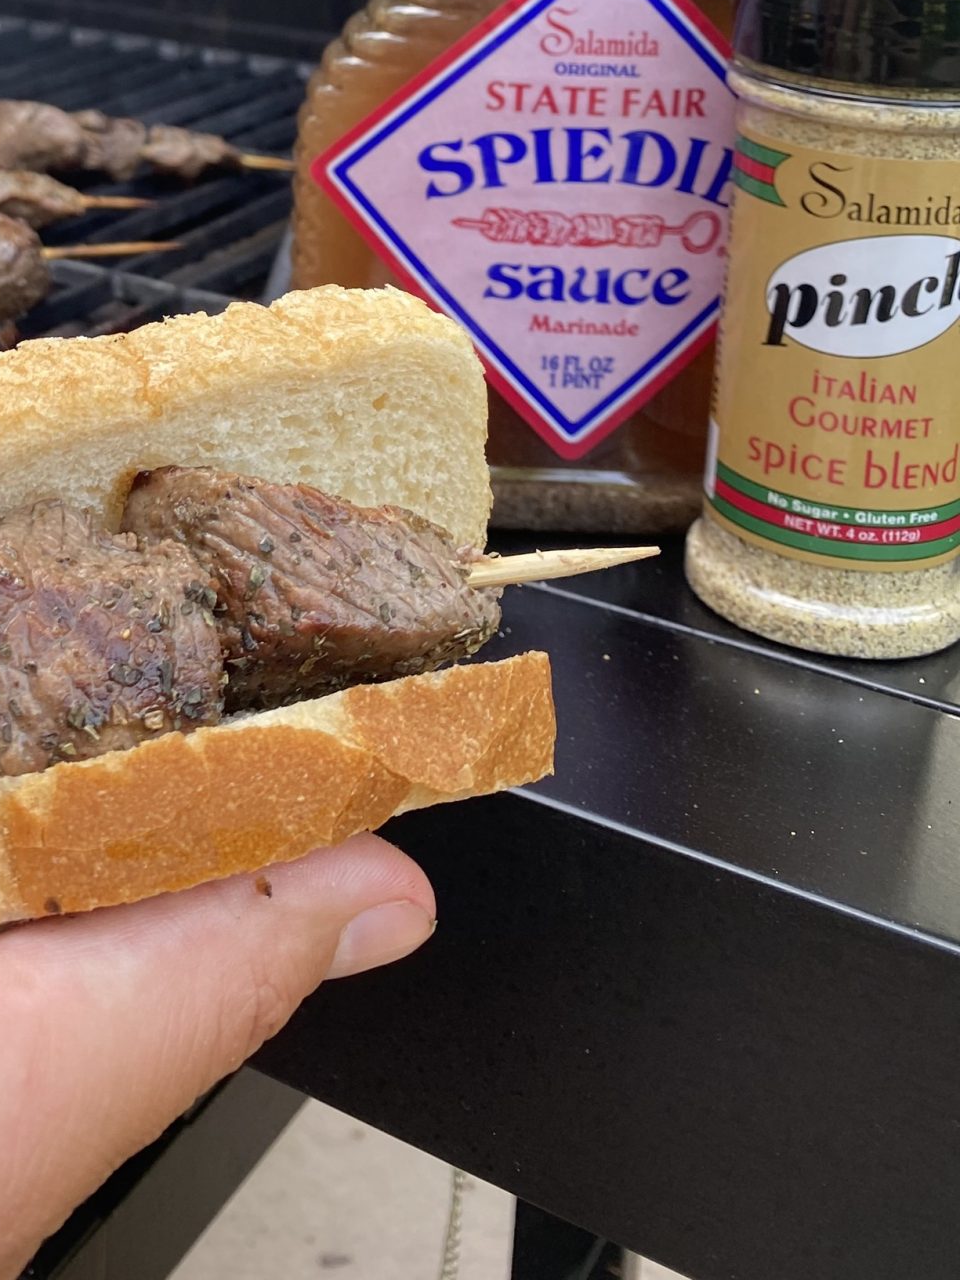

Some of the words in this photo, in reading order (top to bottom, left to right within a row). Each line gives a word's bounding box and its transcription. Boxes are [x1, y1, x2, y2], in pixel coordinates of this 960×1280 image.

[539, 6, 660, 57] Salamida
[553, 62, 640, 77] ORIGINAL
[486, 81, 608, 117] STATE
[621, 88, 706, 118] FAIR
[483, 263, 691, 306] sauce
[528, 314, 640, 337] Marinade
[541, 355, 559, 371] 16
[563, 355, 584, 372] FL
[589, 356, 614, 373] OZ
[562, 373, 604, 390] PINT
[788, 396, 934, 439] GOURMET
[767, 491, 788, 508] No
[791, 499, 839, 521] Sugar
[855, 511, 905, 525] Gluten
[910, 510, 938, 524] Free
[784, 514, 814, 531] NET
[816, 521, 842, 538] WT.
[846, 528, 854, 540] 4
[858, 531, 879, 542] oz.
[882, 529, 921, 543] (112g)
